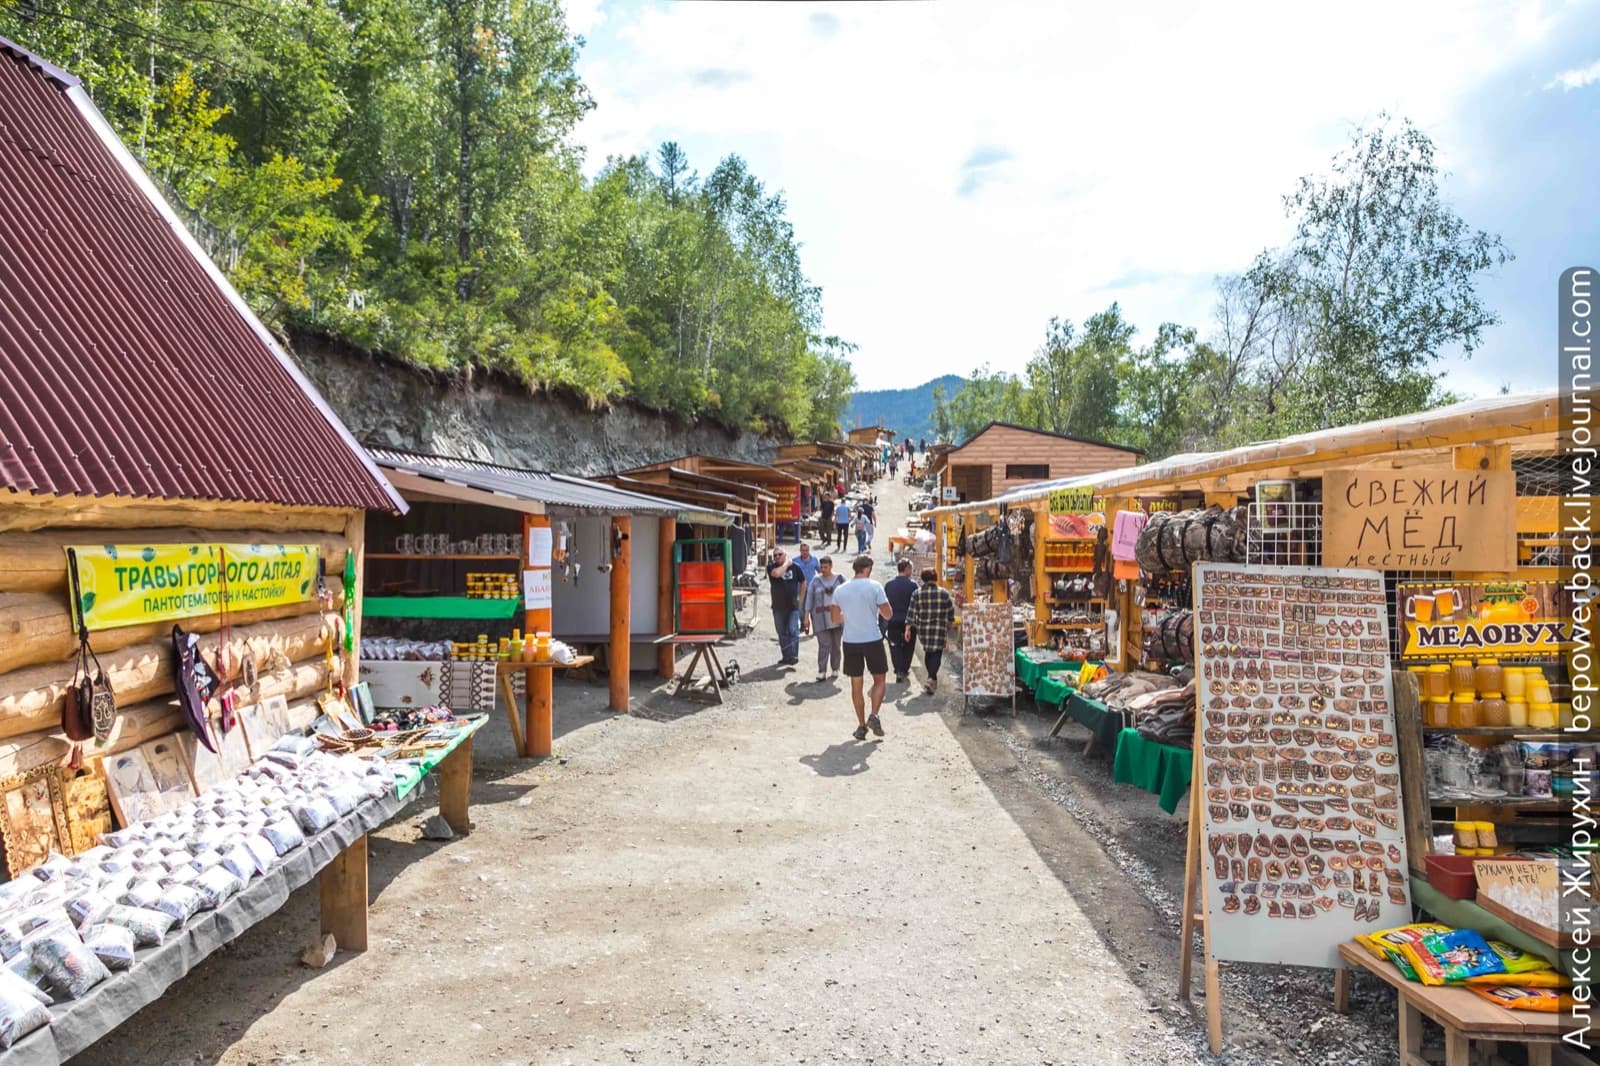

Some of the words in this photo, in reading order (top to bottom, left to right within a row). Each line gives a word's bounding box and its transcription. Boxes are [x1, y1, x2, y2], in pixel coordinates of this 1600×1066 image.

[1346, 475, 1487, 508] СВЕЖИЙ
[1357, 509, 1463, 553] МЁД
[1345, 552, 1451, 567] местный
[114, 565, 183, 592] ТРАВЫ
[187, 562, 259, 586] ГОРНОГО
[261, 560, 301, 581] АЛТАЯ
[143, 590, 234, 613] ПАНТОГЕМАТОГЕН
[235, 589, 241, 599] И
[242, 584, 286, 600] НАСТОЙКИ
[1417, 623, 1592, 648] МЕДОВУХА
[1476, 863, 1514, 877] РУКАМИ
